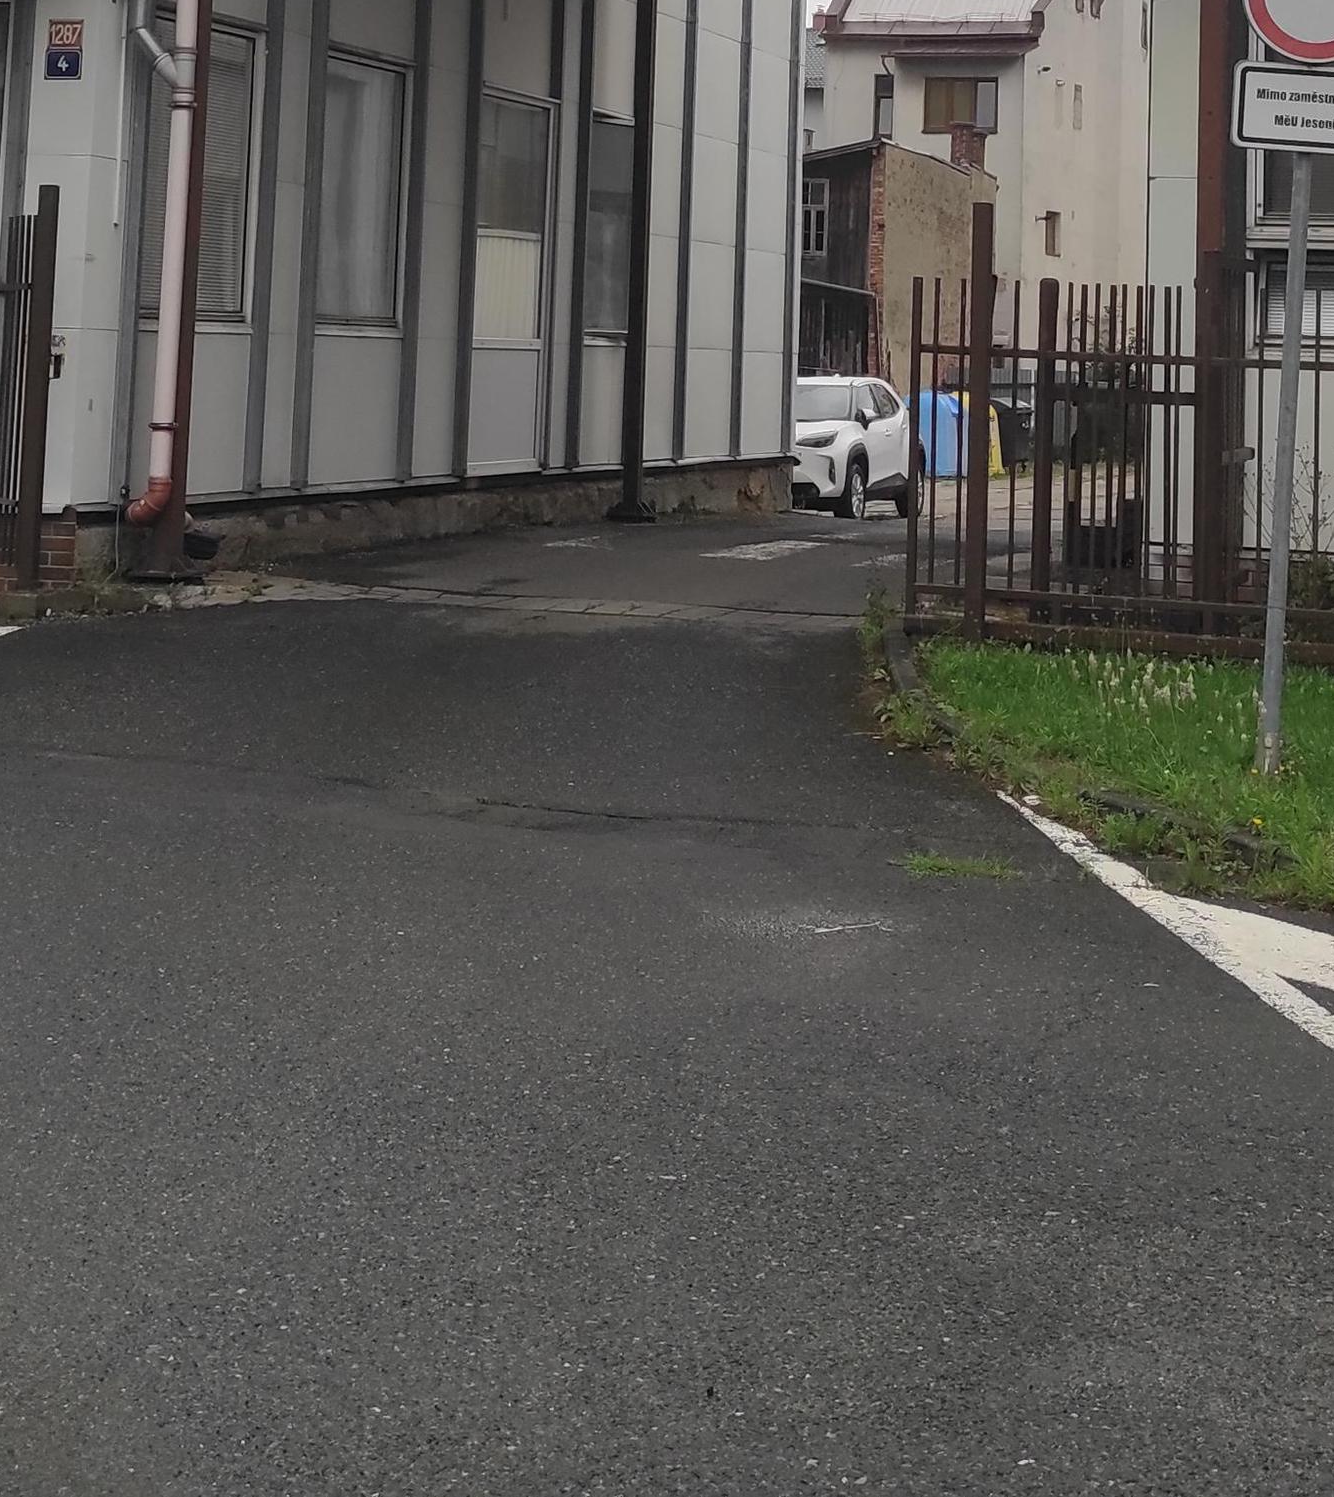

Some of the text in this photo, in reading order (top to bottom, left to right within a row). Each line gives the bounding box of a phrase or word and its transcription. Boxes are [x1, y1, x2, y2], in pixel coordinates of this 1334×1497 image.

[50, 24, 82, 44] 1287
[57, 55, 69, 72] 4
[1256, 88, 1287, 102] Mimo
